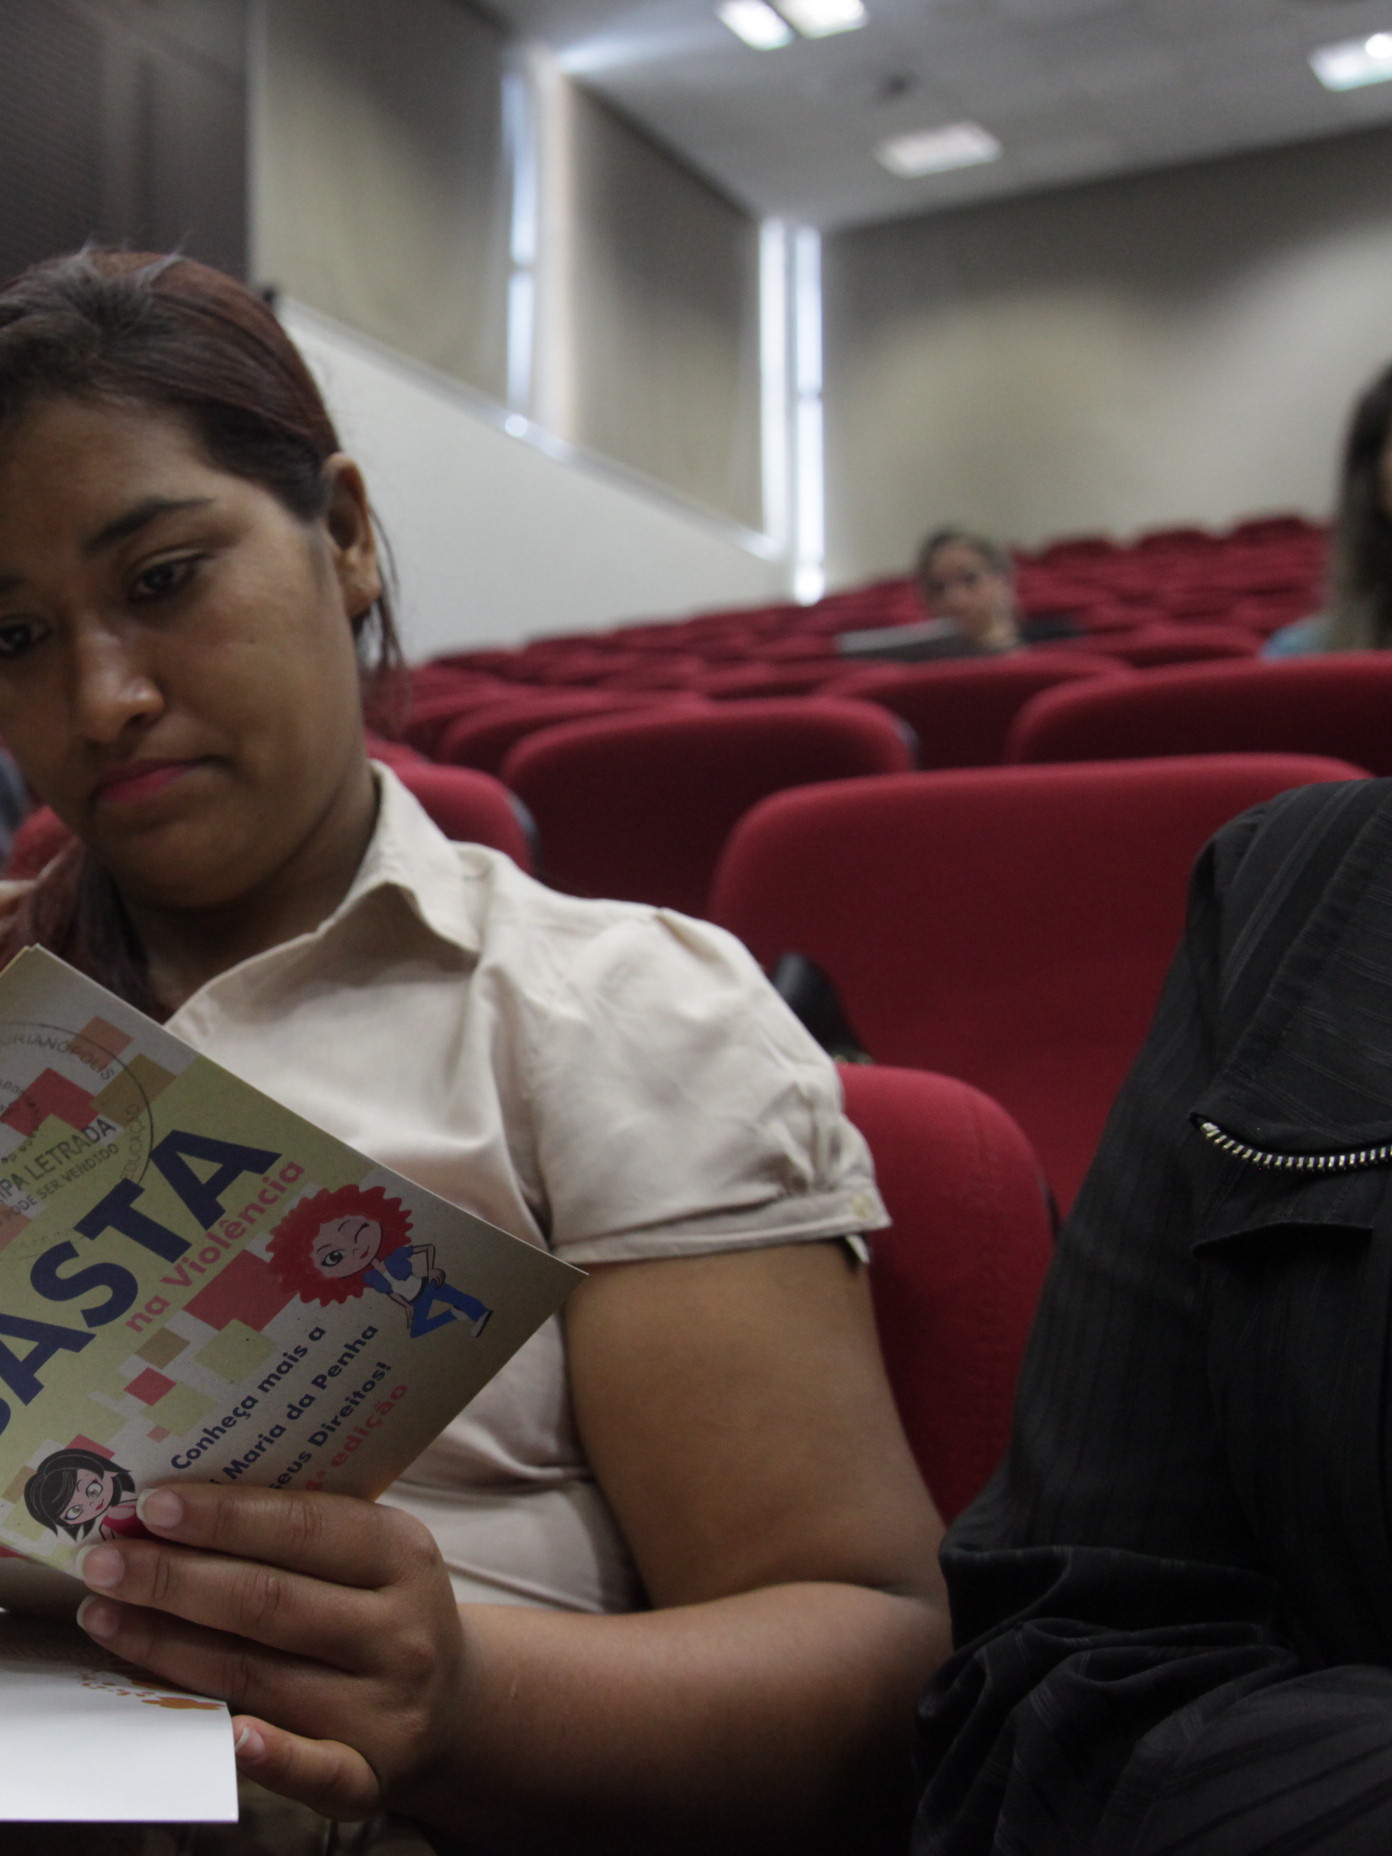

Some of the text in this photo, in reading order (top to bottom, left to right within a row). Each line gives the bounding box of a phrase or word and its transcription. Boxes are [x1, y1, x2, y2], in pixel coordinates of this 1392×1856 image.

[1, 1194, 37, 1224] PODE
[38, 1177, 63, 1200] SER
[61, 1143, 120, 1184] VENDIDO
[24, 1116, 118, 1184] LETRADA
[124, 1160, 306, 1334] na Violência
[170, 1325, 327, 1471] Conheça mais a
[221, 1323, 380, 1481] Maria da Penha
[308, 1360, 393, 1447] Direitos!
[330, 1383, 409, 1467] edição
